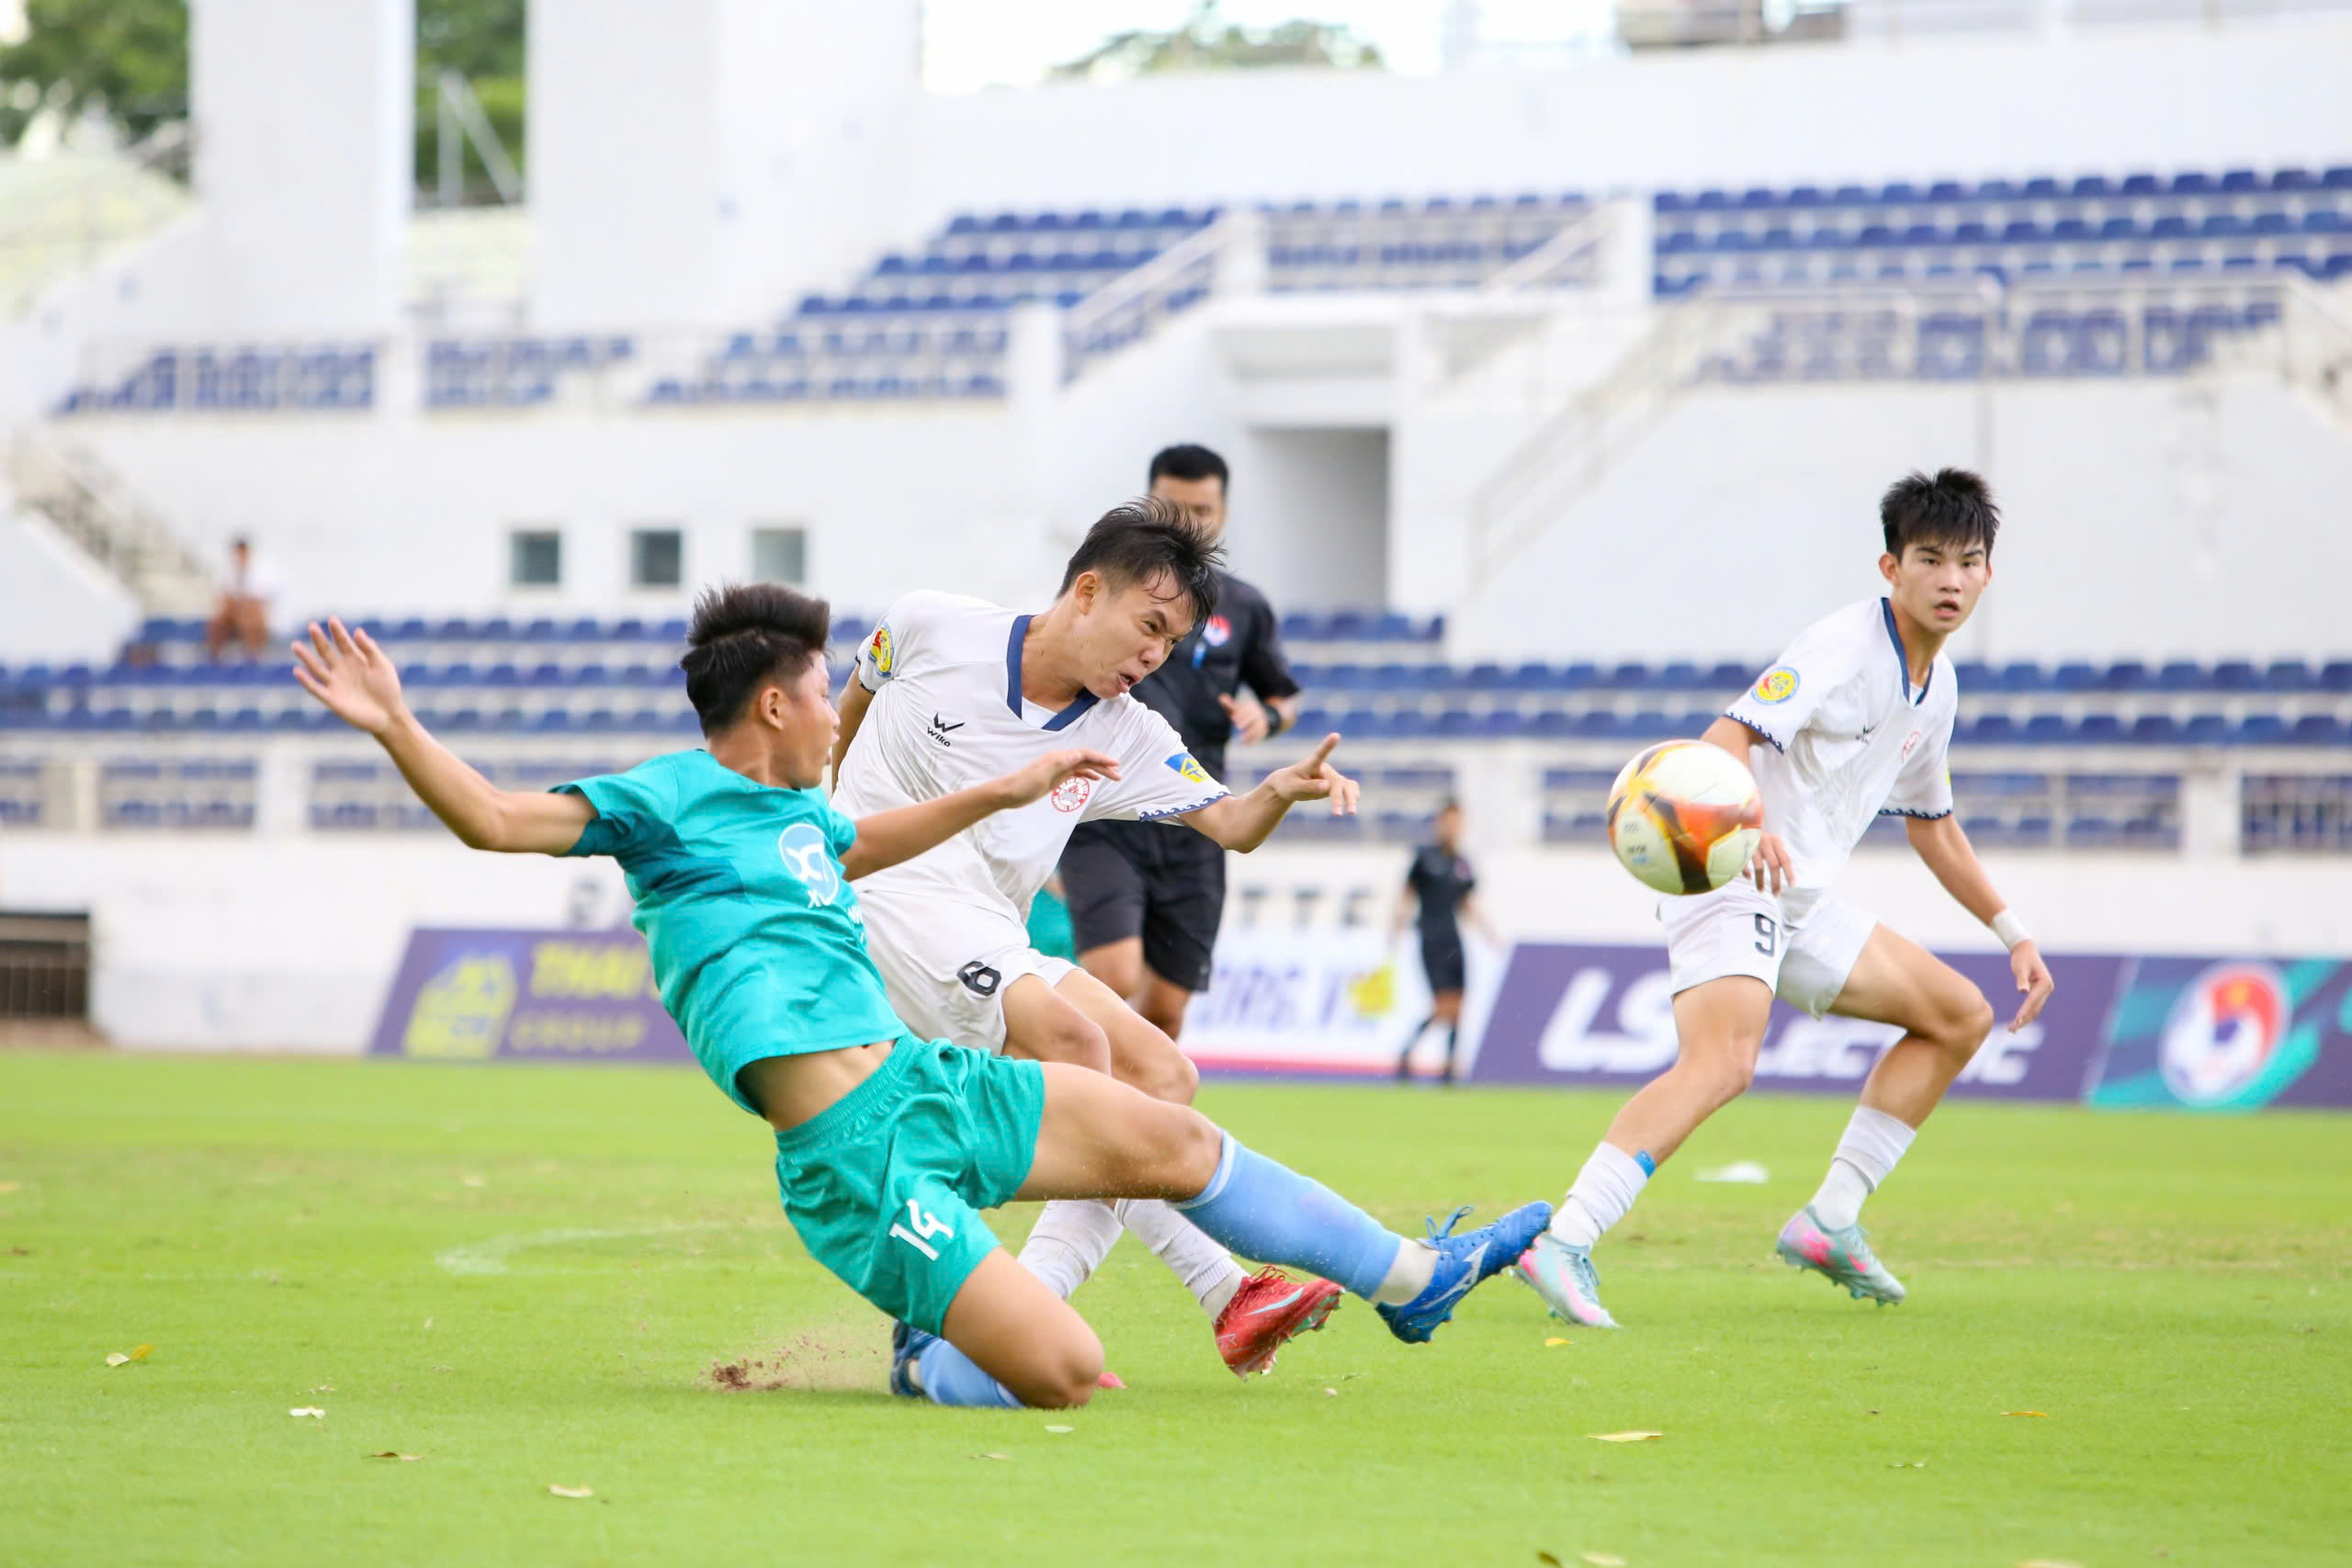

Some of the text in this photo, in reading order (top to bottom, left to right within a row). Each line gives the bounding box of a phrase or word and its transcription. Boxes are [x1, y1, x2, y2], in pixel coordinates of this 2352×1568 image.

[1754, 912, 1776, 957] 9
[1536, 967, 1679, 1074] LS
[888, 1198, 955, 1261] 14
